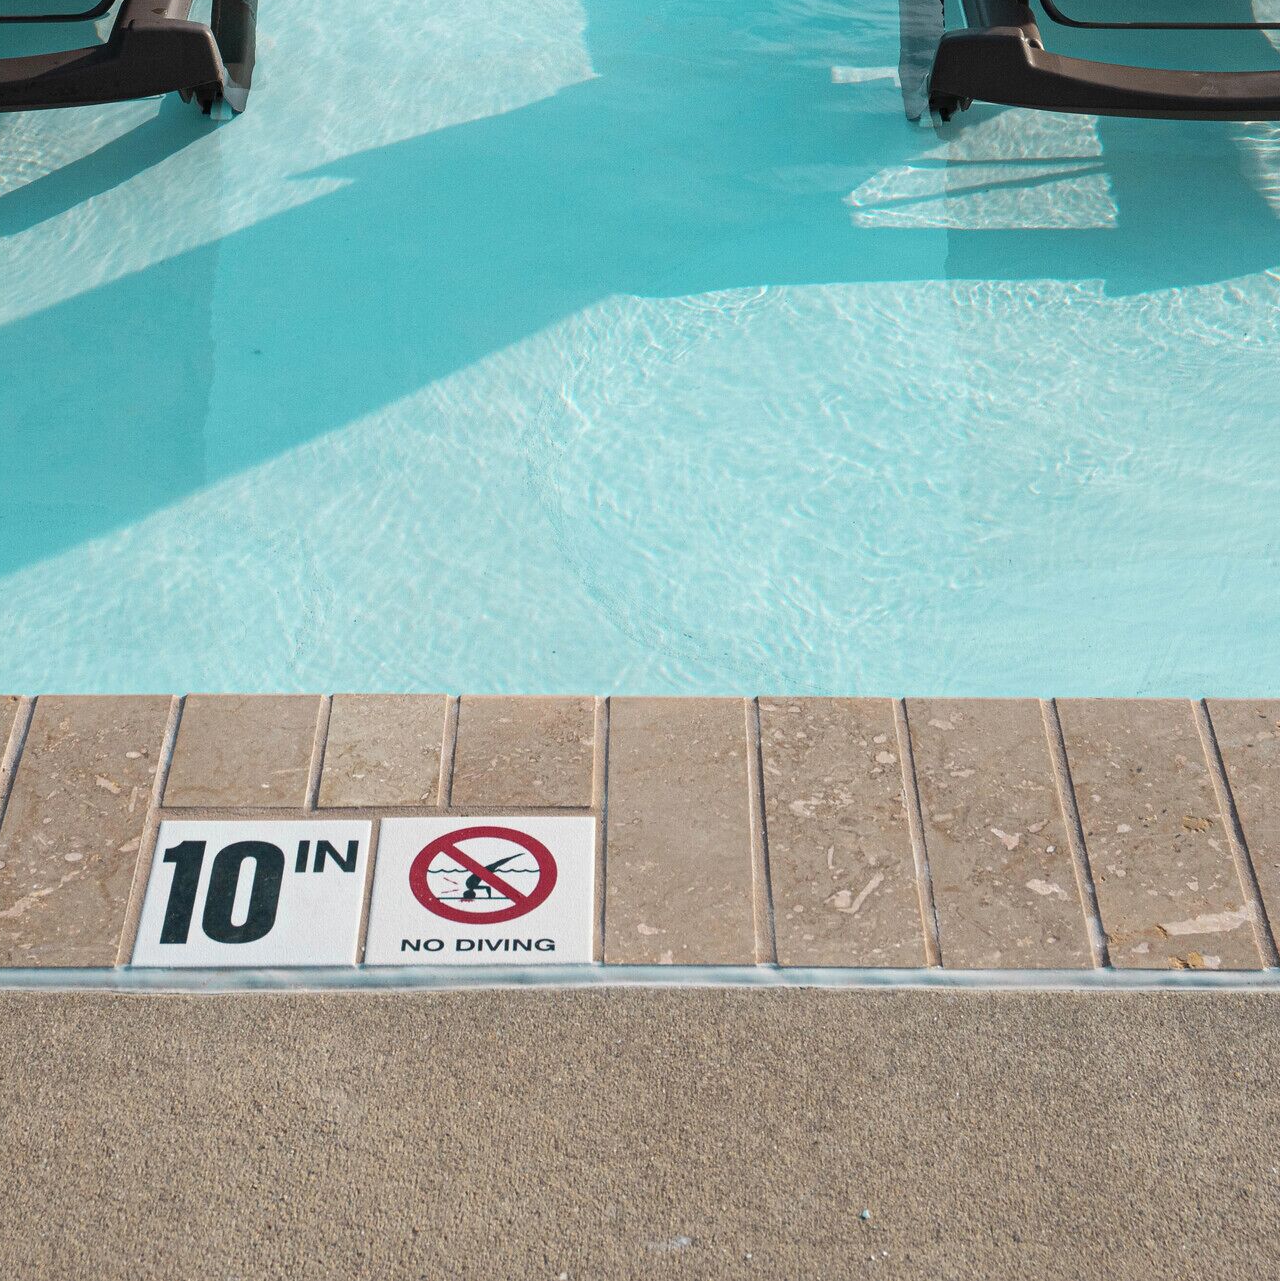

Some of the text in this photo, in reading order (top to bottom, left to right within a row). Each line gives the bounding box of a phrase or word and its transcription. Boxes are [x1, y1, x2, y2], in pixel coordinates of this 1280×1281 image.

[159, 840, 359, 945] 10 IN
[401, 938, 556, 952] NO DIVING
